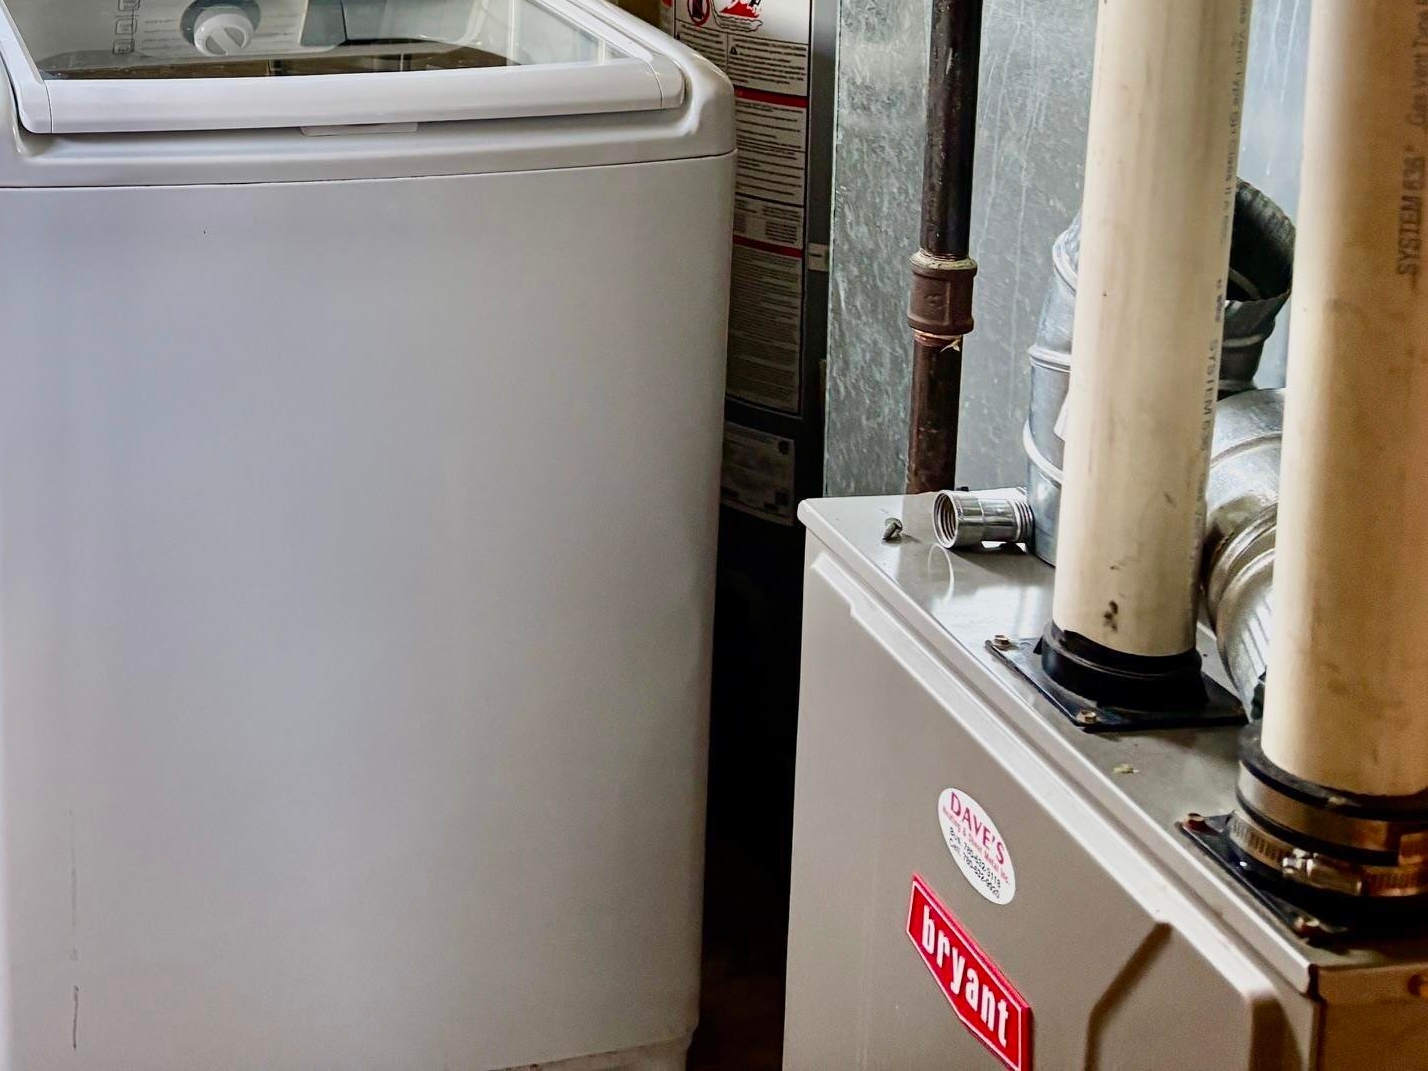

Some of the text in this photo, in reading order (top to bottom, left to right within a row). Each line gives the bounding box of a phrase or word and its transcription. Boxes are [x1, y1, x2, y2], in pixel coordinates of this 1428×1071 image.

[1395, 195, 1422, 276] SYSTEM
[950, 791, 1005, 866] DAVE'S
[921, 903, 1010, 1049] bryant
